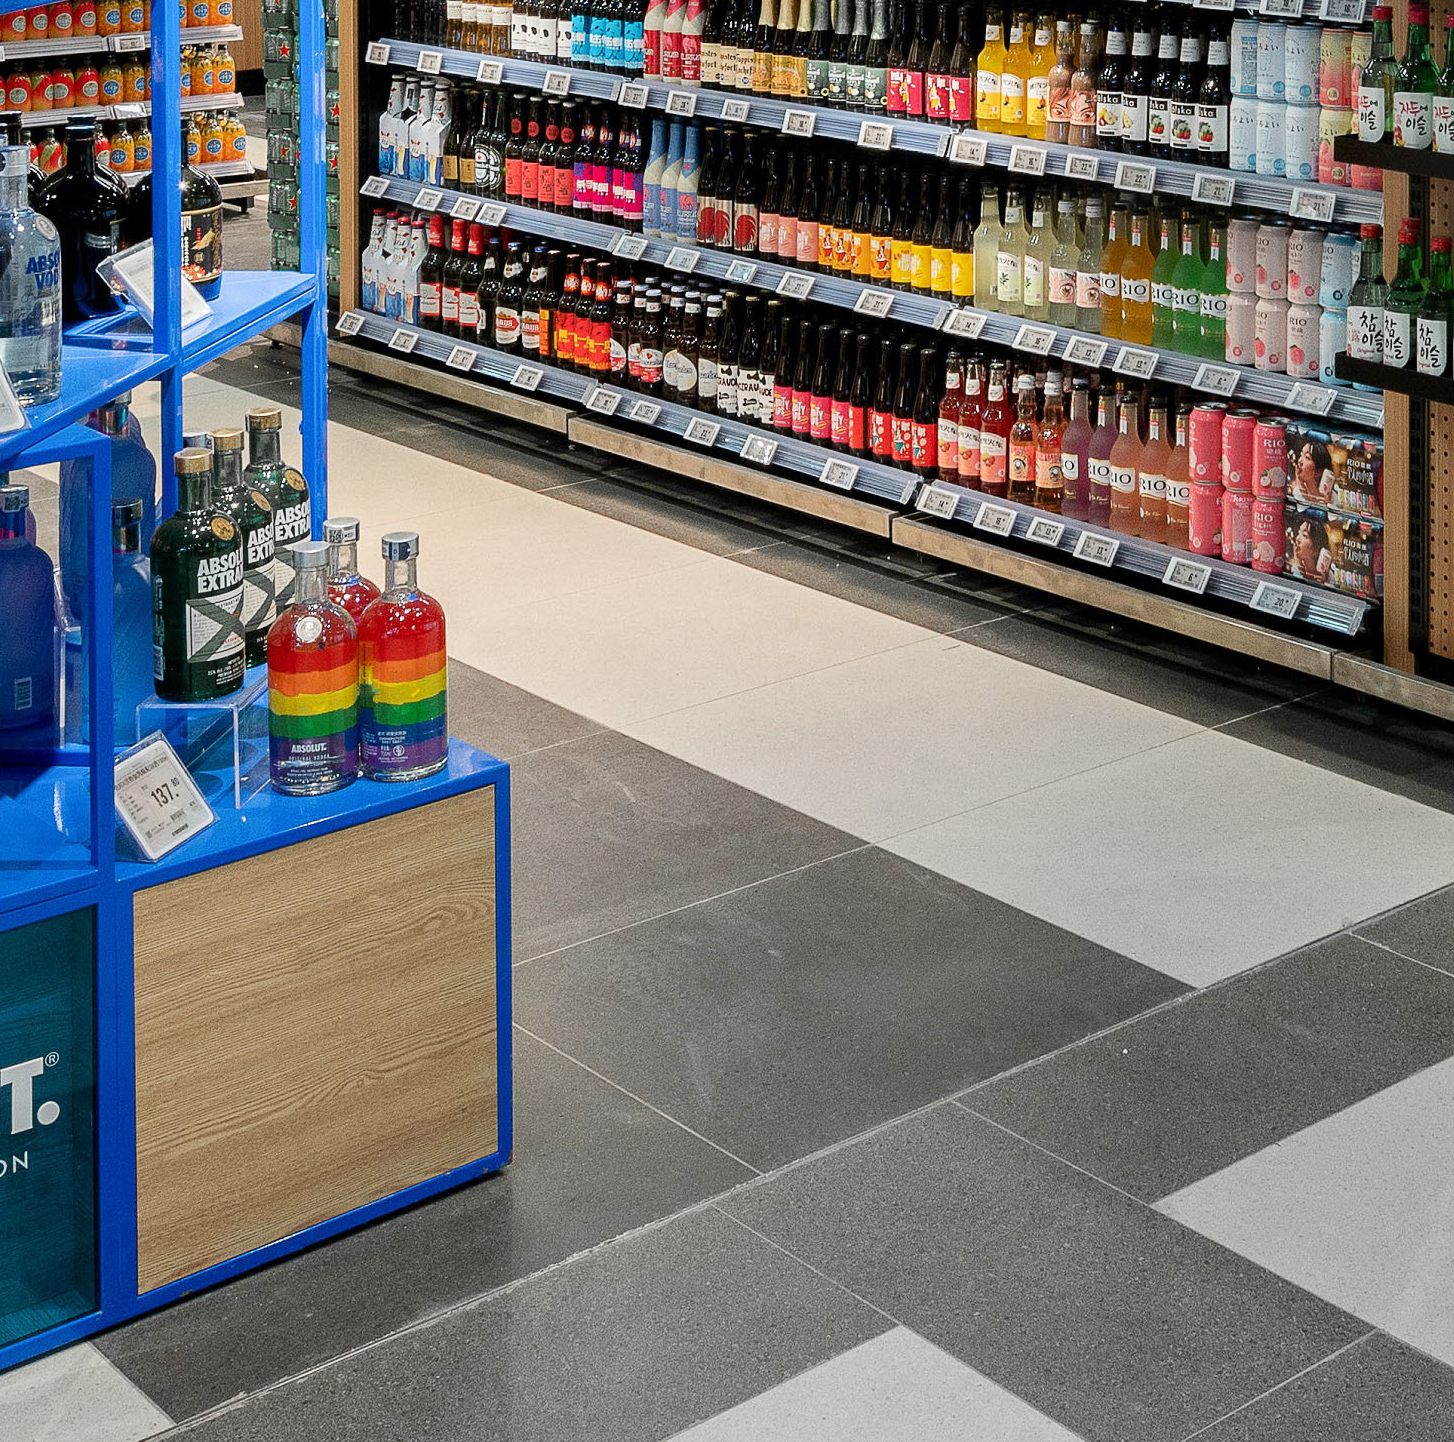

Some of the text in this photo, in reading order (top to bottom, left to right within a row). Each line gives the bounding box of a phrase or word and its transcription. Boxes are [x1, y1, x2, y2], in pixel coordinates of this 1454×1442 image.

[1399, 101, 1429, 115] 자두에
[1405, 115, 1427, 136] 이슬
[1289, 242, 1304, 252] RIO
[1101, 277, 1116, 290] IO
[1122, 283, 1147, 297] RIO
[1173, 291, 1199, 309] RIO
[1200, 296, 1227, 312] RIO
[1290, 317, 1307, 327] RIO
[1359, 310, 1379, 333] 참
[1361, 329, 1384, 353] 이슬
[1419, 324, 1434, 344] 참
[1420, 345, 1441, 368] 이슬
[1263, 438, 1286, 448] RIO
[1139, 477, 1166, 491] RIO
